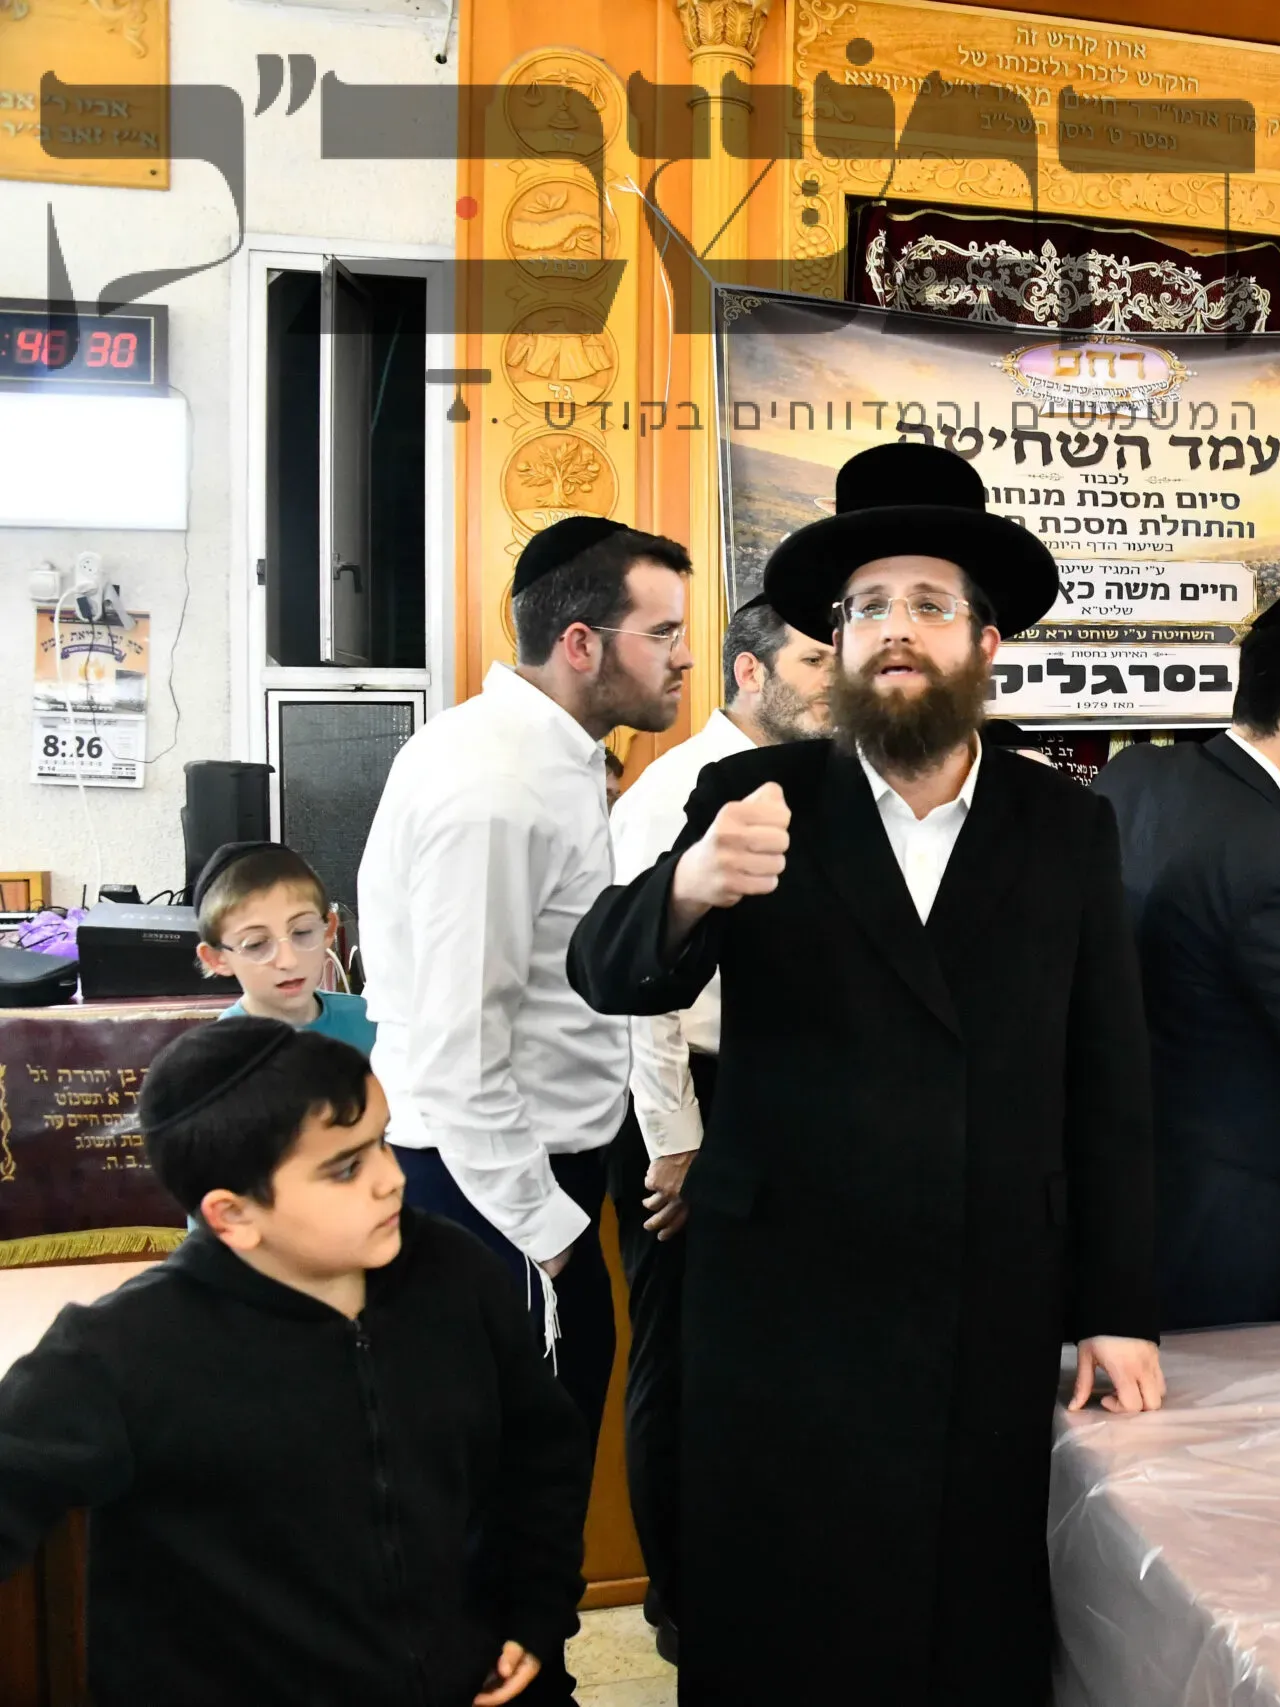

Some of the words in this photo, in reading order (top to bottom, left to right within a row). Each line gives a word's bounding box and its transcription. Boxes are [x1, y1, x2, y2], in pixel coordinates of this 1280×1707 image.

[1016, 26, 1039, 46] זה
[1047, 31, 1098, 55] קודש
[958, 45, 987, 67] של
[1106, 39, 1147, 60] ארון
[996, 54, 1069, 77] ולזכותו
[1077, 62, 1129, 84] לזכרו
[1137, 71, 1200, 94] הוקדש
[989, 80, 1051, 107] מאיר
[85, 332, 138, 368] 30
[547, 383, 574, 400] גד
[896, 420, 1152, 470] השחיטה
[1080, 473, 1129, 485] לכבוד
[1077, 489, 1165, 508] מסכת
[1176, 491, 1241, 510] סיום
[1038, 516, 1128, 535] מסכת
[1139, 514, 1255, 538] והתחלת
[1086, 540, 1117, 552] הדף
[1122, 541, 1174, 552] בשיעור
[1057, 564, 1094, 575] שיעו
[1099, 565, 1141, 575] המגיד
[1105, 581, 1170, 601] משה
[1180, 583, 1238, 601] חיים
[1046, 629, 1073, 640] ירא
[1078, 629, 1119, 640] שוחט
[1152, 629, 1215, 641] השחיטה
[1071, 650, 1107, 658] בחסות
[1111, 650, 1148, 659] האירוע
[43, 734, 103, 759] 8:26
[57, 1068, 110, 1084] יהודה
[117, 1068, 138, 1088] בן
[67, 1113, 100, 1128] חיים
